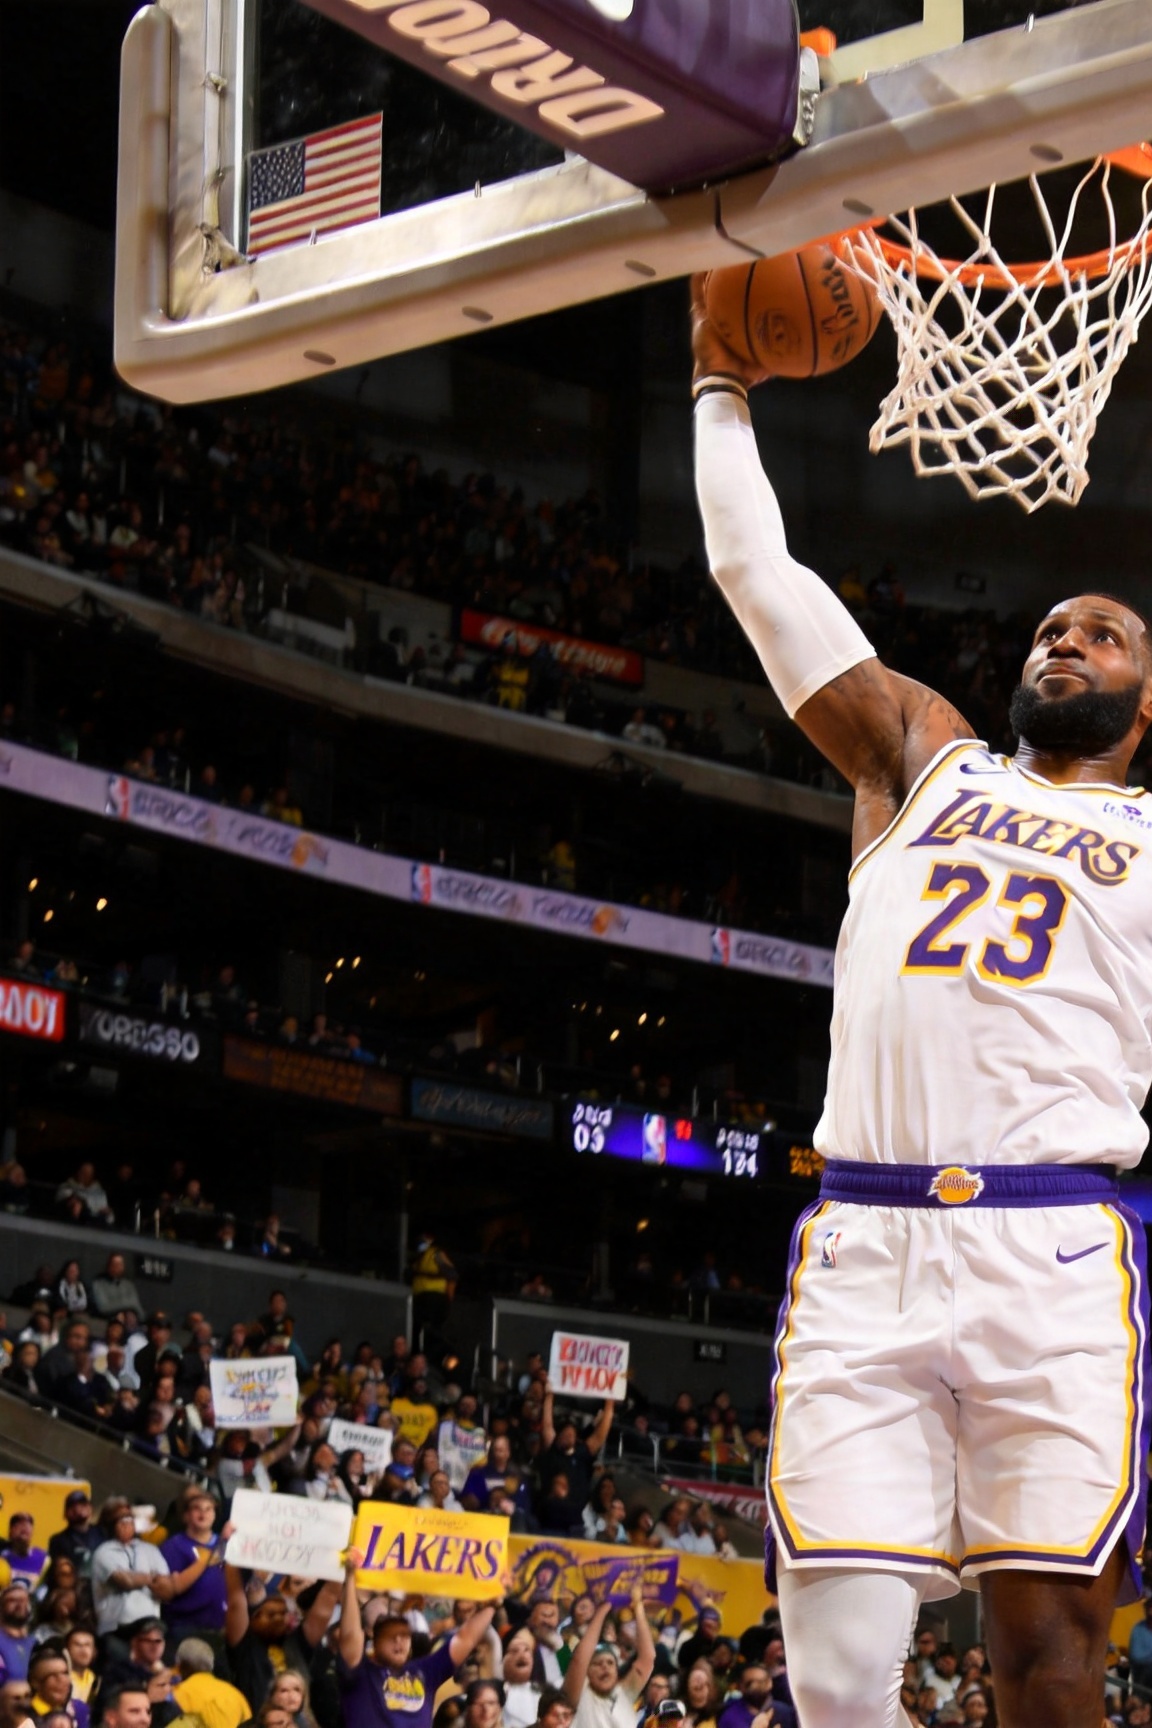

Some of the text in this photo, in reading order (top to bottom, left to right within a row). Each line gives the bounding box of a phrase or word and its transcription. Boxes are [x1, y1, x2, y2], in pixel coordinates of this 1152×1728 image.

[904, 788, 1142, 887] LAKERS
[898, 859, 1073, 990] 23
[361, 1524, 504, 1581] LAKERS
